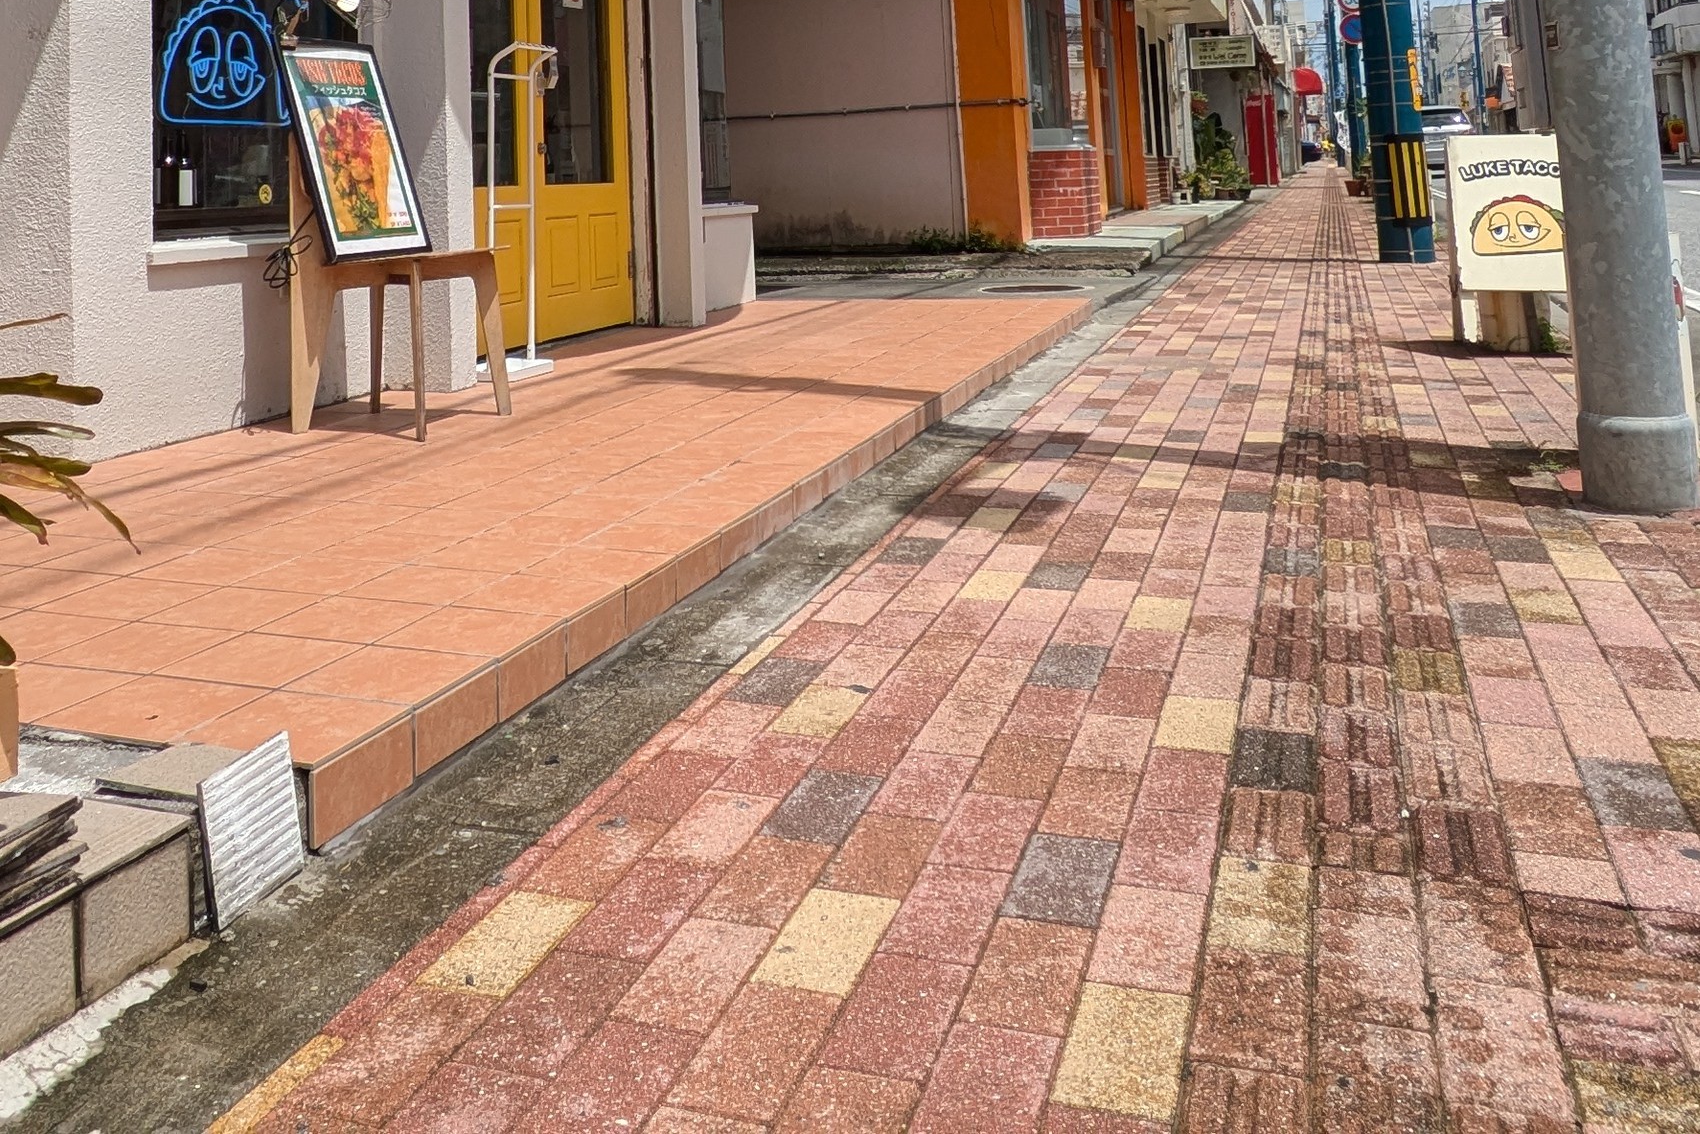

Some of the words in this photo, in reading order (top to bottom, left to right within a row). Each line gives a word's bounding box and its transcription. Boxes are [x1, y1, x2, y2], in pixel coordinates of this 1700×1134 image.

[327, 61, 368, 88] TACOS
[312, 84, 368, 97] フィッシュタコス
[1459, 160, 1511, 182] LUKE
[1509, 159, 1561, 178] TACO
